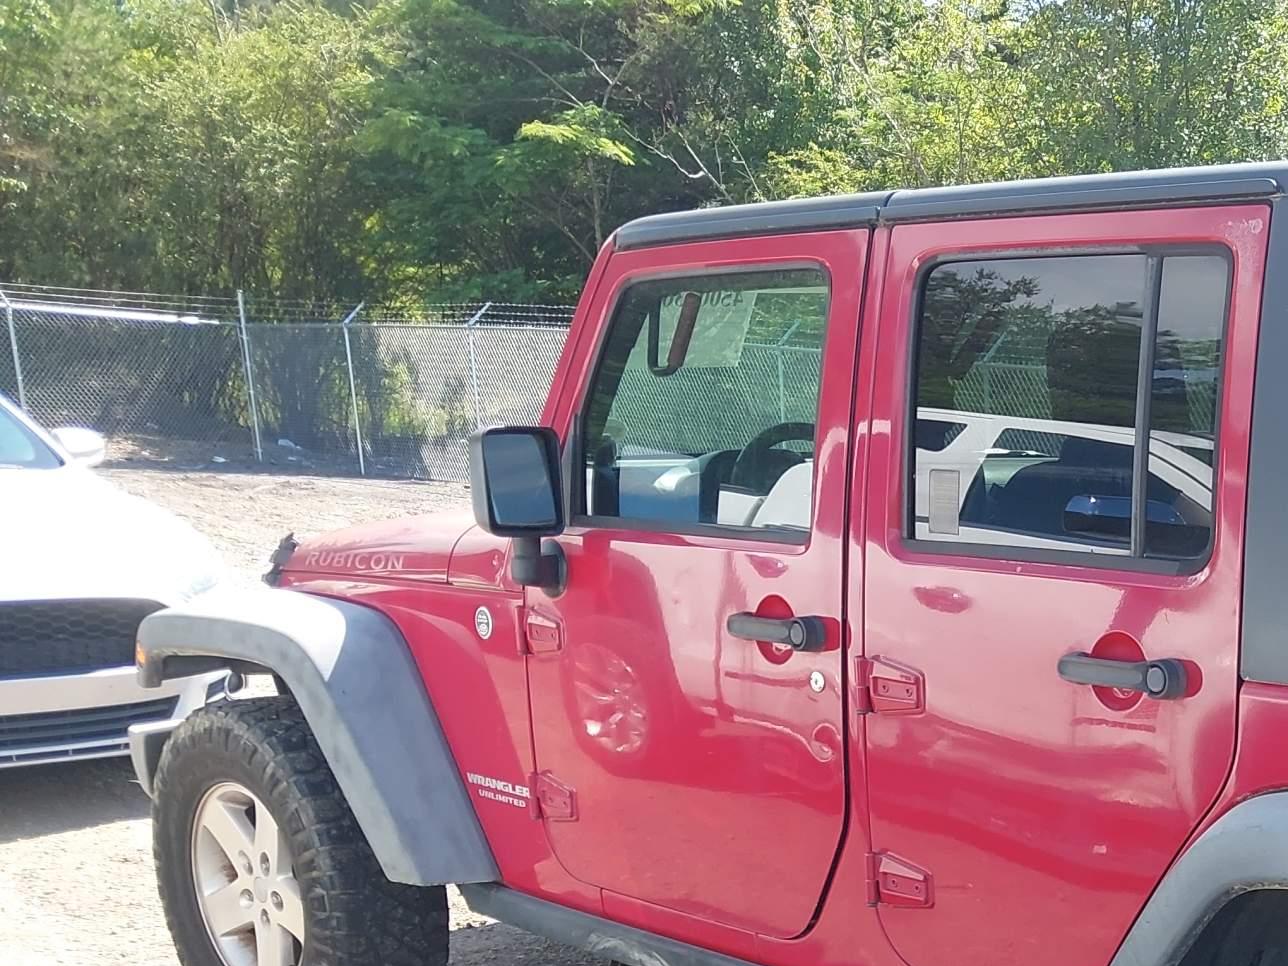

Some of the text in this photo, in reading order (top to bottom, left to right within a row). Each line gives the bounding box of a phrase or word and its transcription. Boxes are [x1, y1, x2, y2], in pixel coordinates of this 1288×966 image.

[305, 551, 404, 570] RUBICON
[466, 772, 531, 799] WRANGLER
[478, 788, 527, 808] UNLIMITED
